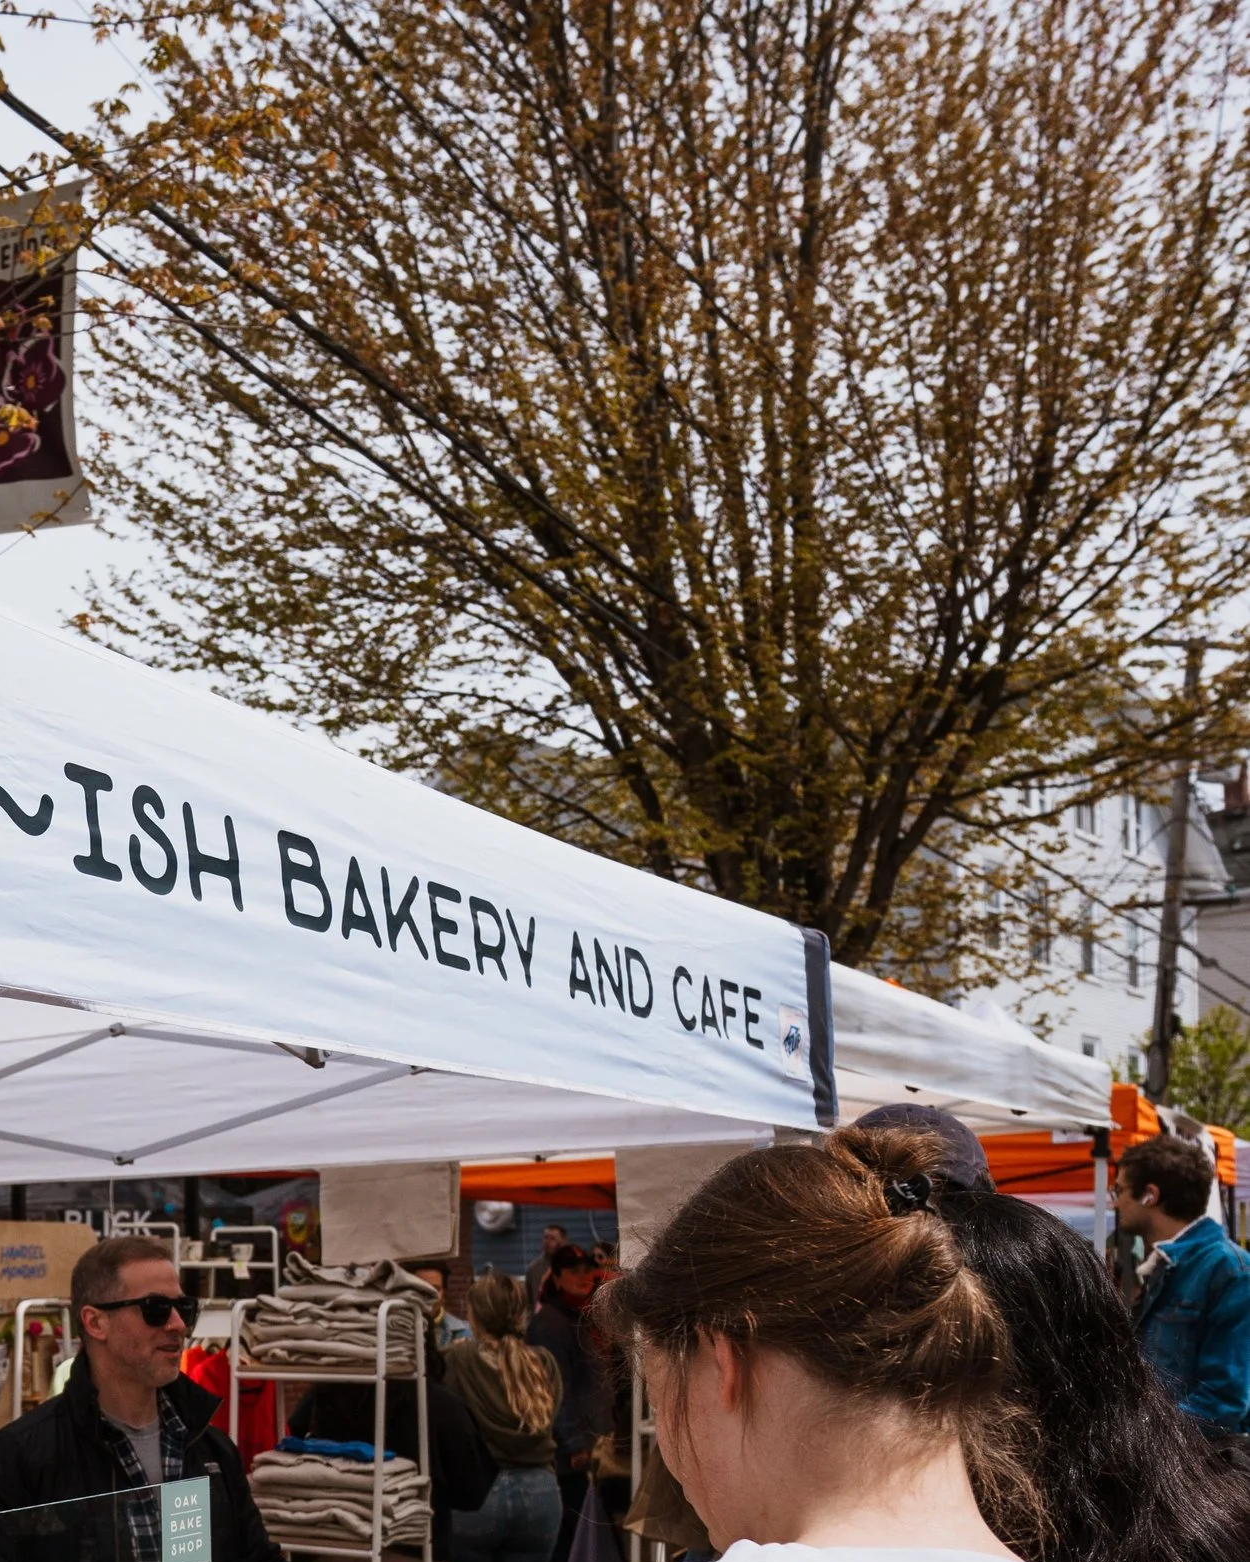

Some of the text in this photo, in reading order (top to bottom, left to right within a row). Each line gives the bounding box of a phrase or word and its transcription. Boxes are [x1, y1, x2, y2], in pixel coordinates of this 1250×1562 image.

[278, 830, 535, 988] BAKERY
[570, 931, 653, 1018] AND
[673, 966, 764, 1050] CAFE
[174, 1494, 197, 1508] OAK
[170, 1516, 202, 1532] BAKE
[171, 1539, 203, 1556] SHOP
